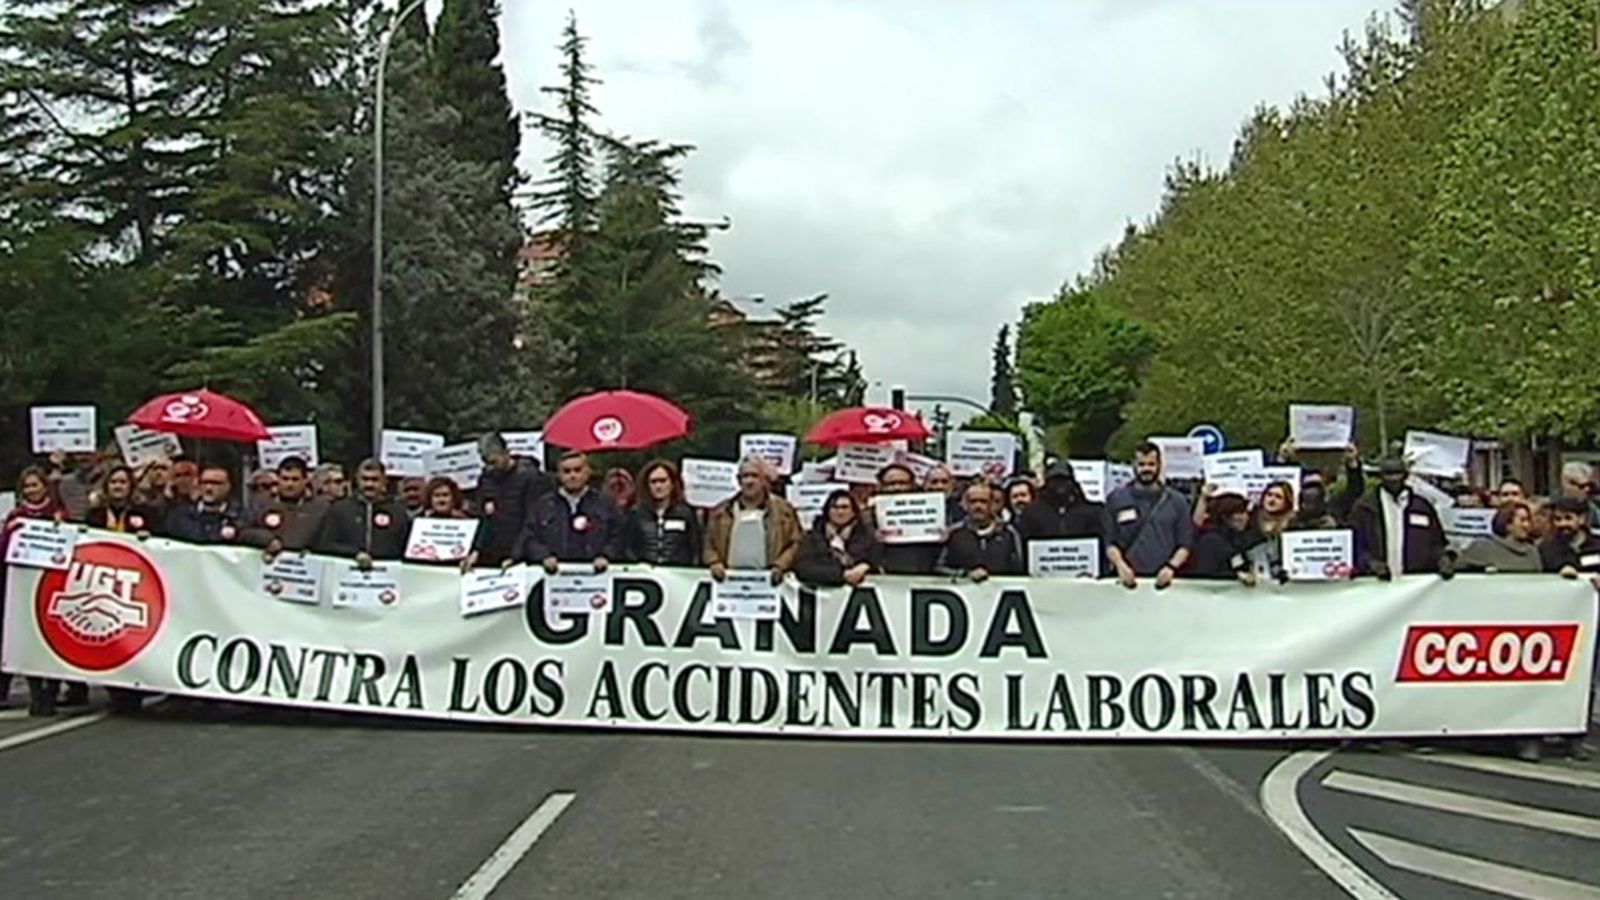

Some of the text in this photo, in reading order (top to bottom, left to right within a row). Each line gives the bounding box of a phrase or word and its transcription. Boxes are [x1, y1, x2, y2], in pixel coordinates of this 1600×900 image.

[65, 561, 141, 602] UGT
[526, 576, 1048, 659] GRANADA
[177, 634, 1376, 732] CONTRA LOS ACCIDENTES LABORALES
[1414, 632, 1562, 676] CC.OO.
